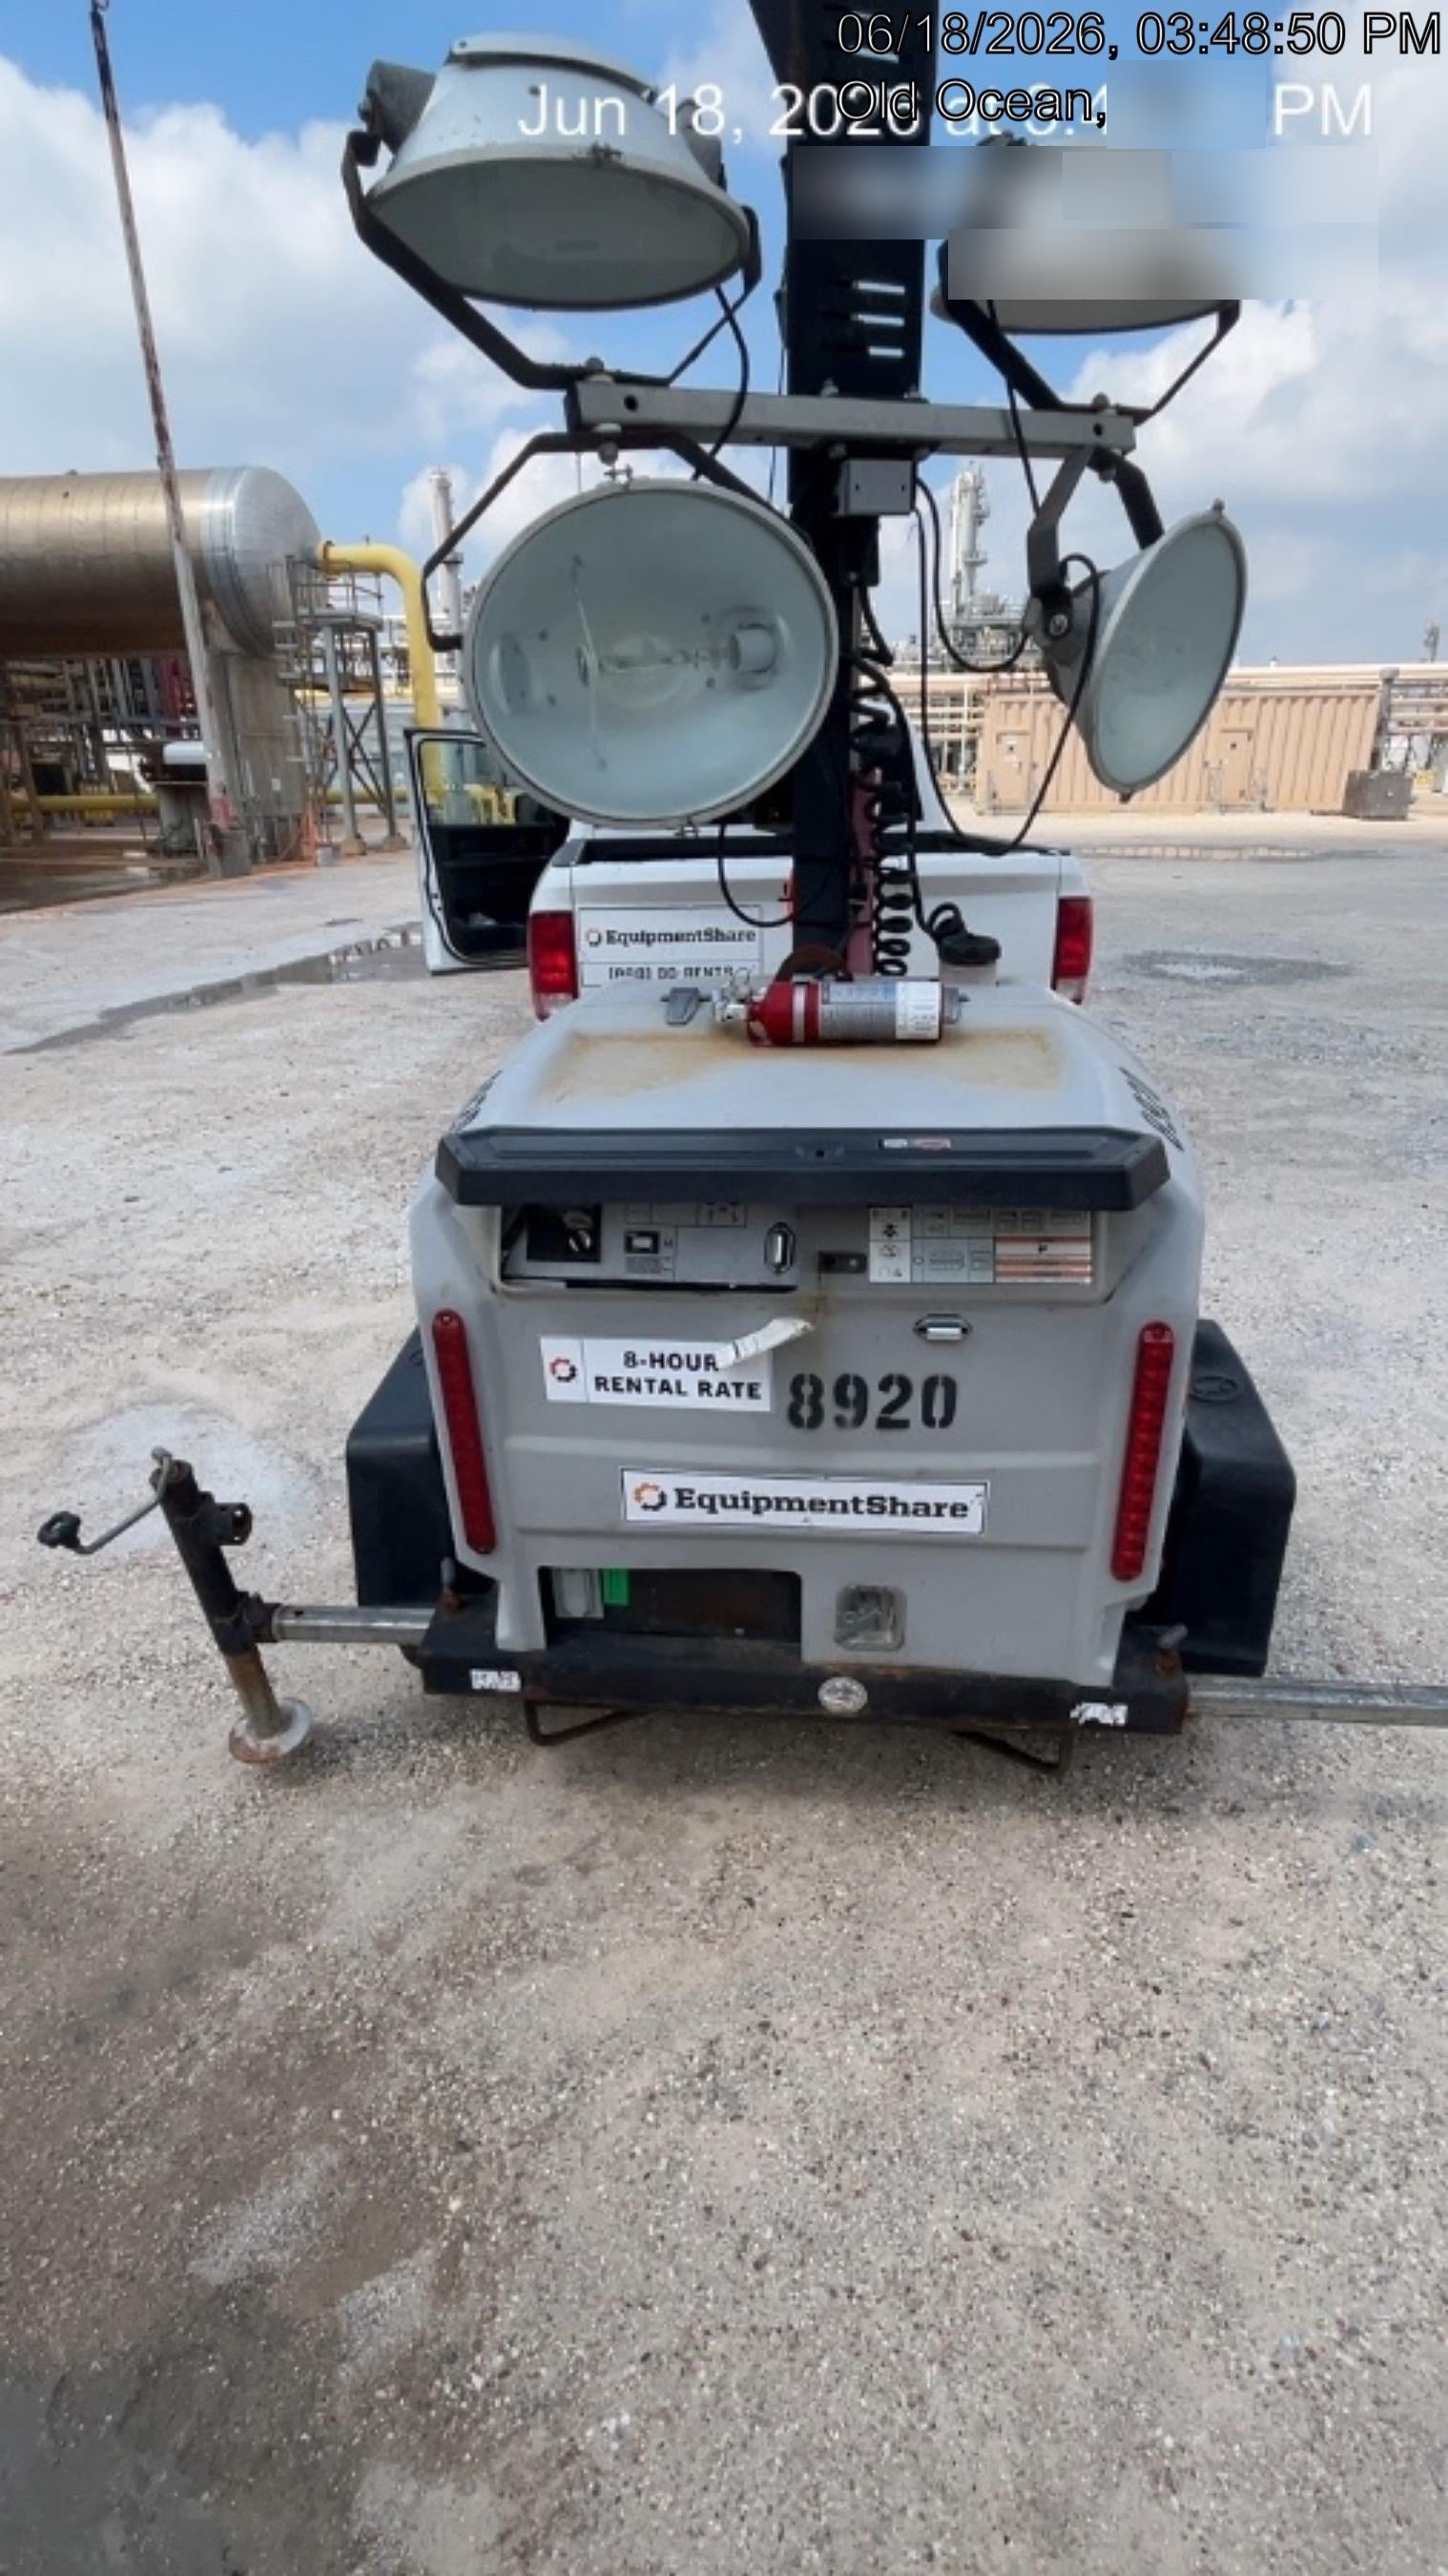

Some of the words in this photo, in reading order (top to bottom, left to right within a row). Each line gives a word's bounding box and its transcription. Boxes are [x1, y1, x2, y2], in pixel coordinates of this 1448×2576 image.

[606, 926, 756, 948] EquipmentShare
[623, 1350, 719, 1372] 8-HOUR
[594, 1375, 689, 1397] RENTAL
[697, 1381, 763, 1401] RATE
[787, 1373, 957, 1429] 8920
[674, 1487, 969, 1519] EquipmentShare
